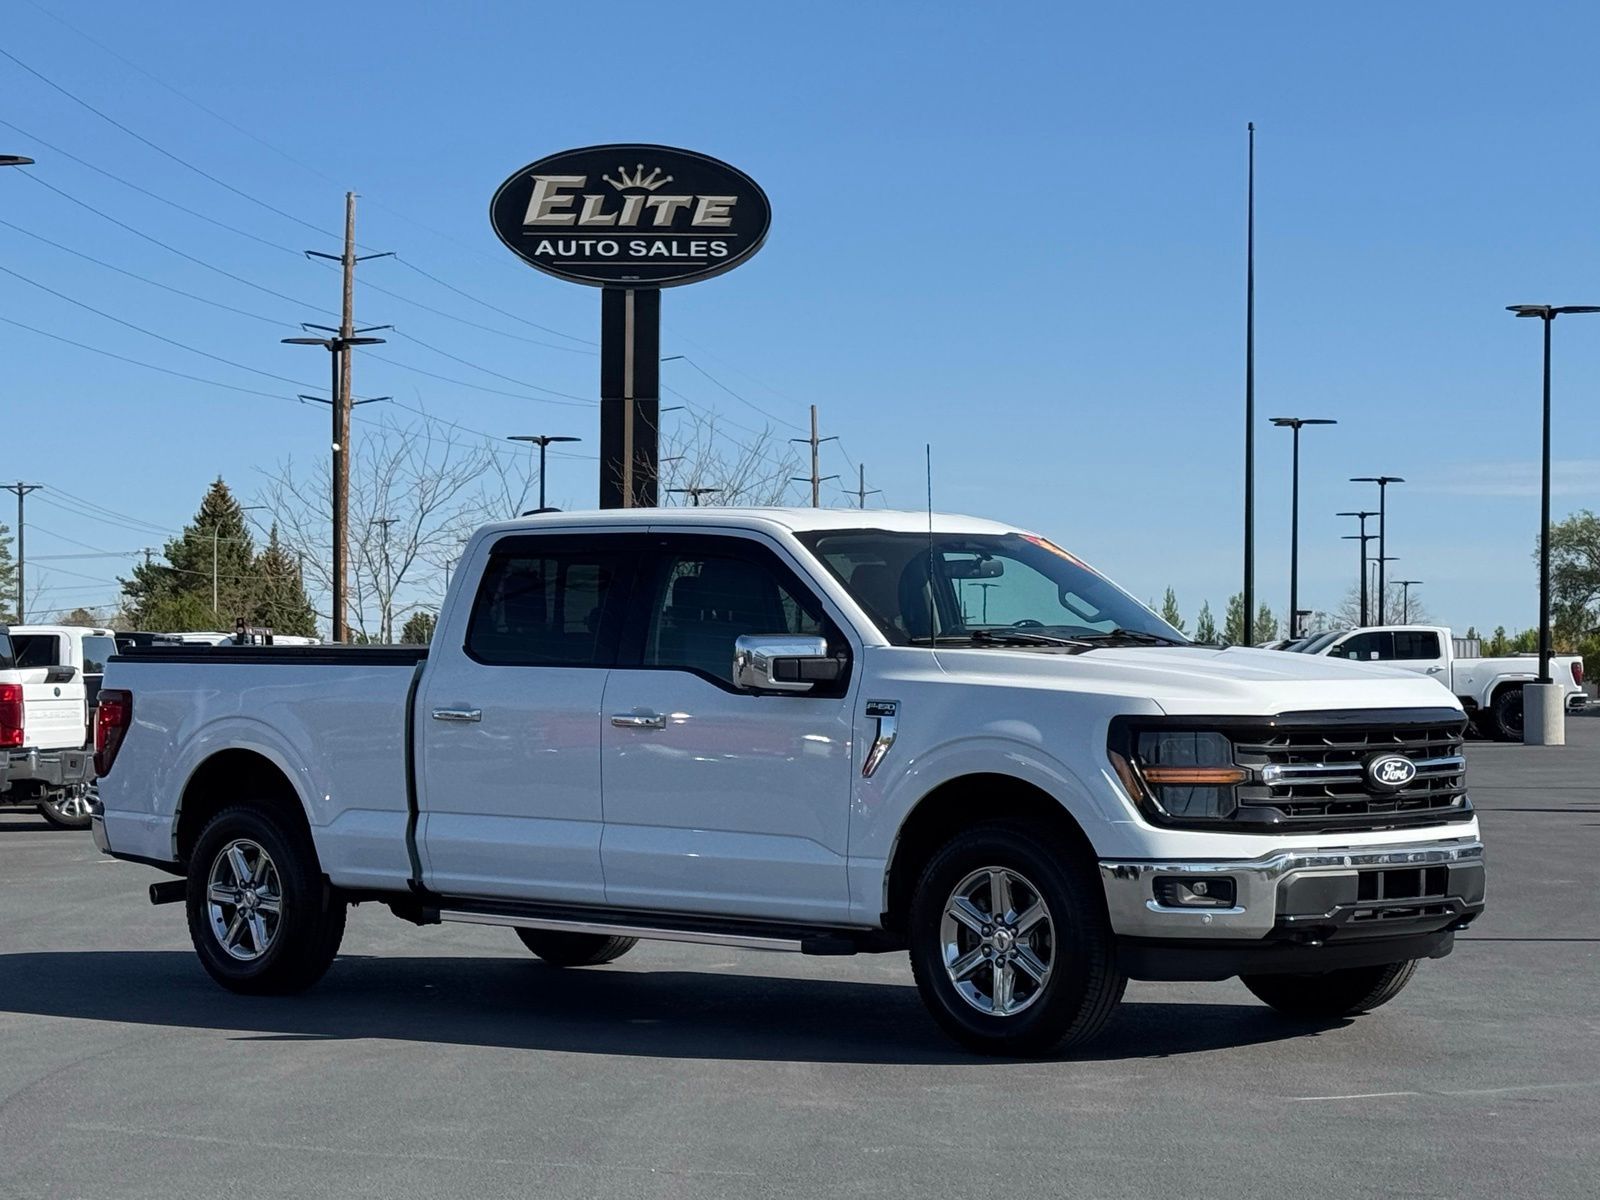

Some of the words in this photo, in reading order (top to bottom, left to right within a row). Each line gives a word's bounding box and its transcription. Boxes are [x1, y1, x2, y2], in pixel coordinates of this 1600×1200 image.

[522, 174, 738, 227] ELITE
[534, 240, 619, 257] AUTO
[629, 240, 728, 257] SALES
[1382, 762, 1408, 780] Ford
